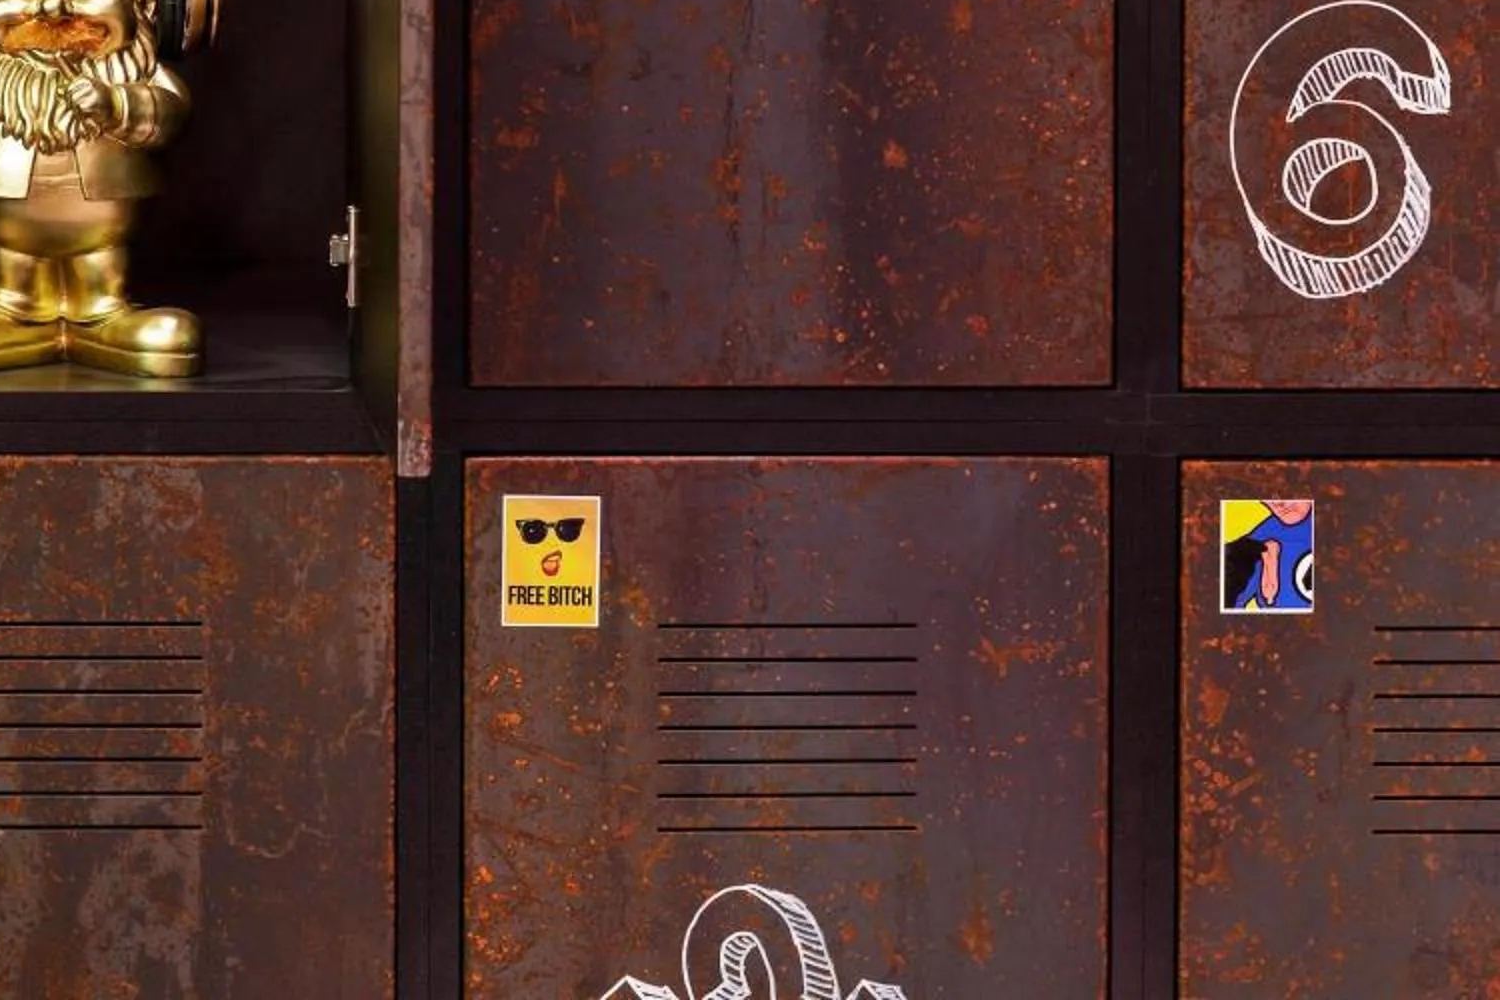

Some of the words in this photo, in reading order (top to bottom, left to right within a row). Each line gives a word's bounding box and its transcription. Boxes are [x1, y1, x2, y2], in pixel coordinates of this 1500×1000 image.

[1229, 0, 1451, 299] 6
[508, 585, 545, 605] FREE
[547, 585, 593, 606] BITCH
